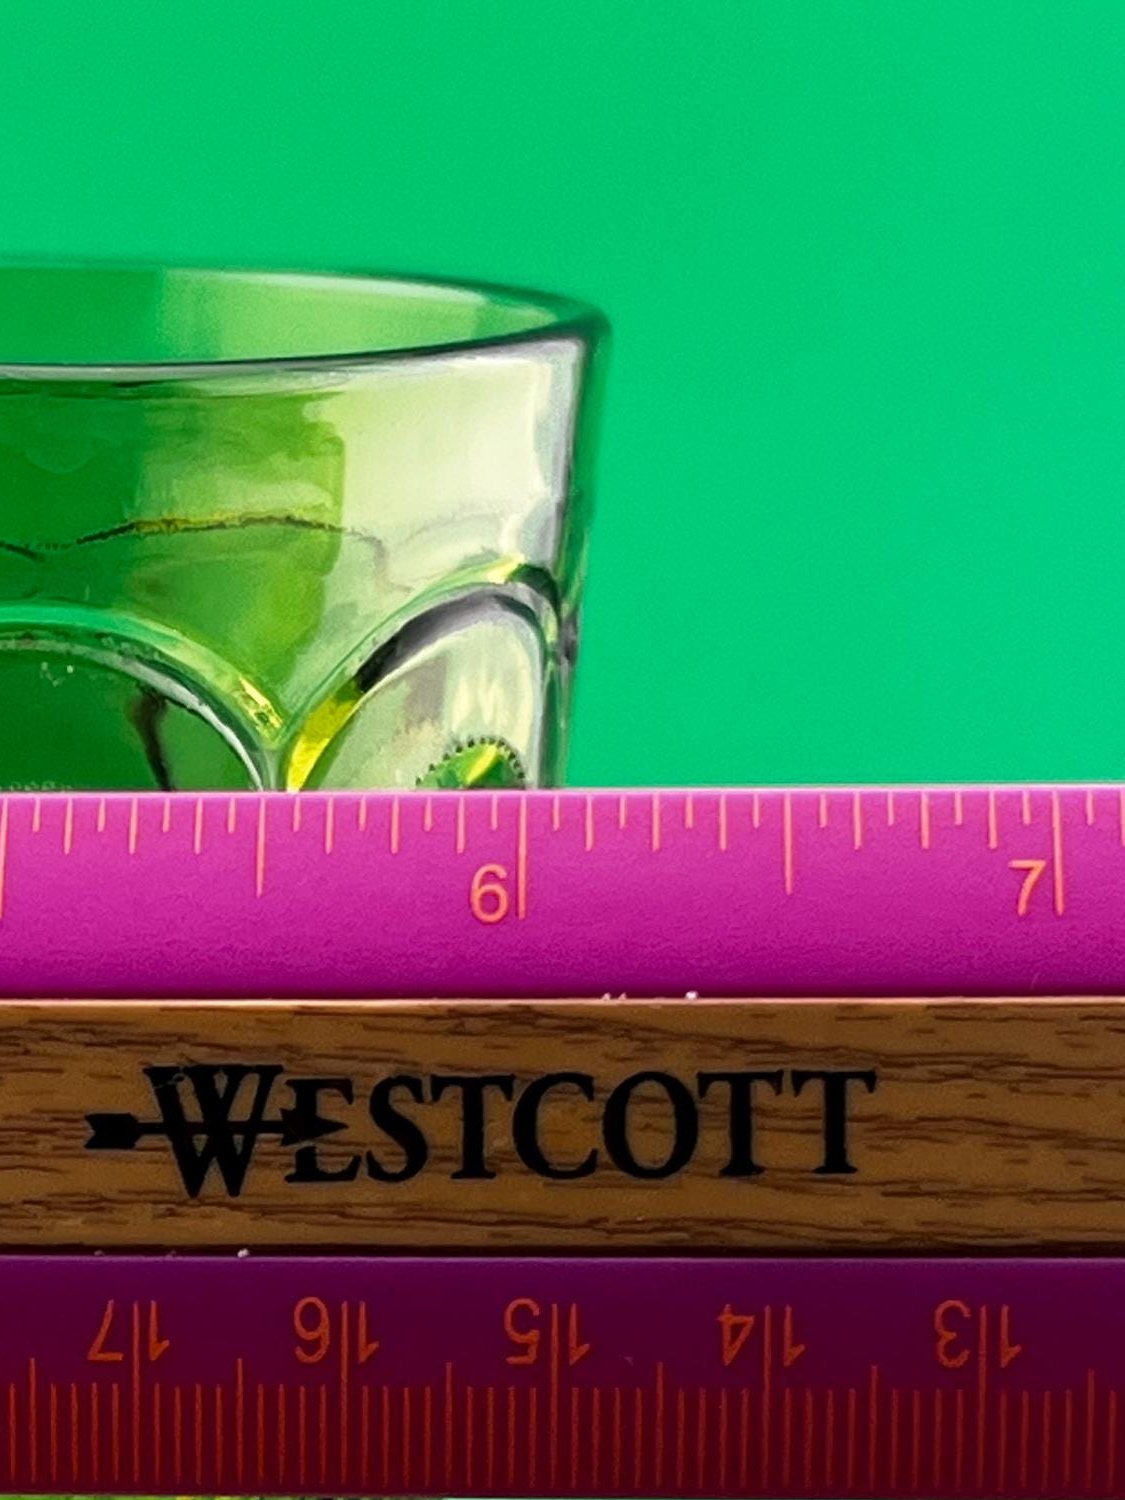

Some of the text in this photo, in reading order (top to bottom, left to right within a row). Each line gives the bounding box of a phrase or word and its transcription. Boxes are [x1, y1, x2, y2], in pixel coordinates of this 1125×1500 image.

[470, 865, 508, 921] 6
[1008, 861, 1045, 915] 7
[143, 1064, 876, 1198] WESTCOTT
